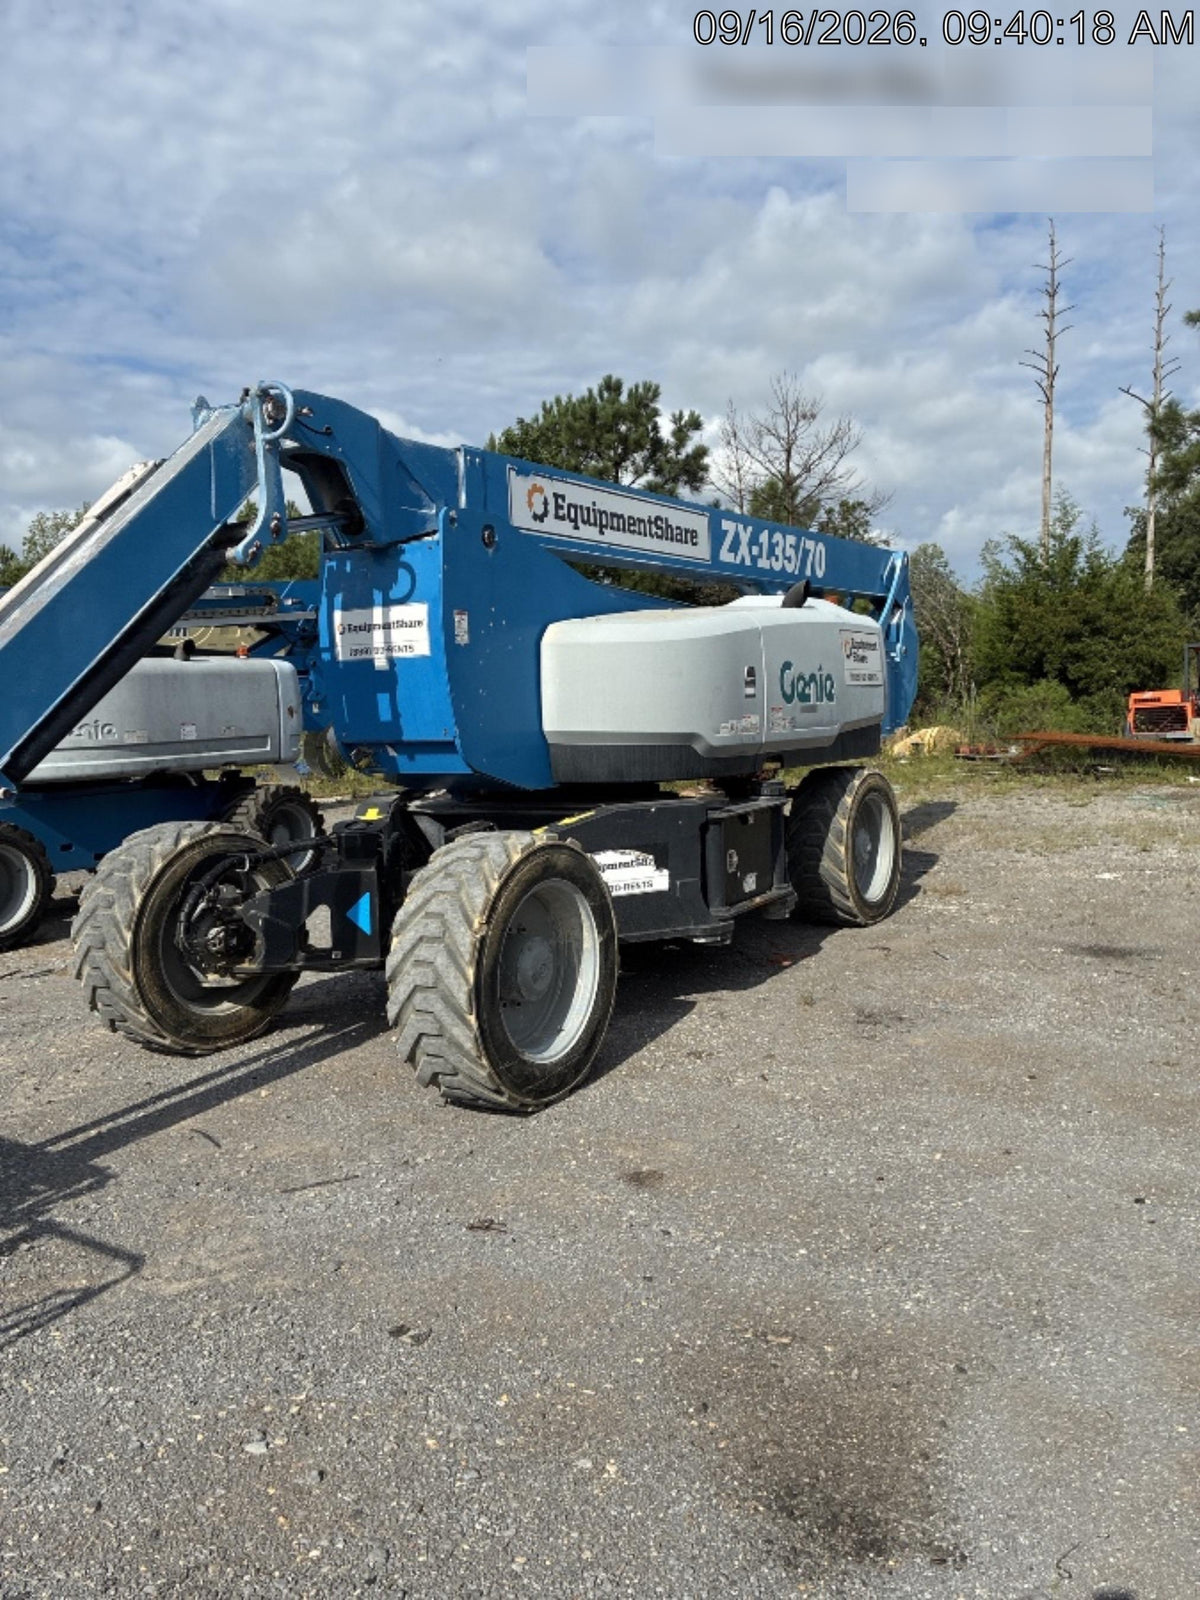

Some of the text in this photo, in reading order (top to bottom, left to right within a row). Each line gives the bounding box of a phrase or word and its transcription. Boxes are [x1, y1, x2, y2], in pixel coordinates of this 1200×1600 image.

[552, 491, 699, 547] EquipmentShare
[719, 518, 826, 579] ZX-135/70
[780, 660, 836, 704] Genie
